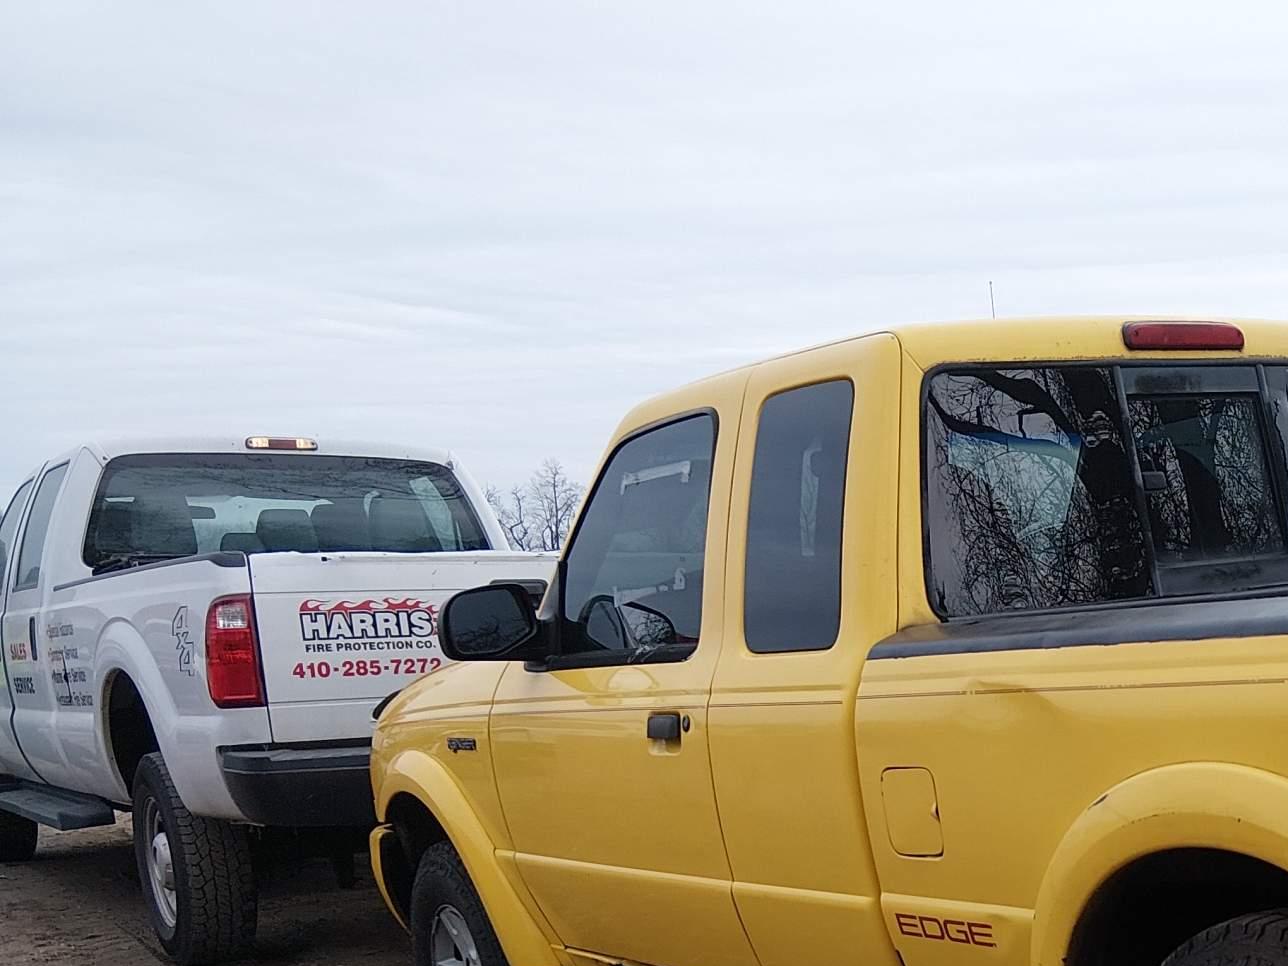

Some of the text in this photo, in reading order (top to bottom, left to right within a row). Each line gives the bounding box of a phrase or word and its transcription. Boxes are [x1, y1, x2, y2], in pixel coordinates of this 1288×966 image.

[300, 609, 434, 641] HARRIS
[10, 642, 27, 661] SALES
[305, 640, 437, 653] FIRE PROTECTION CO.
[895, 913, 997, 948] EDGE
